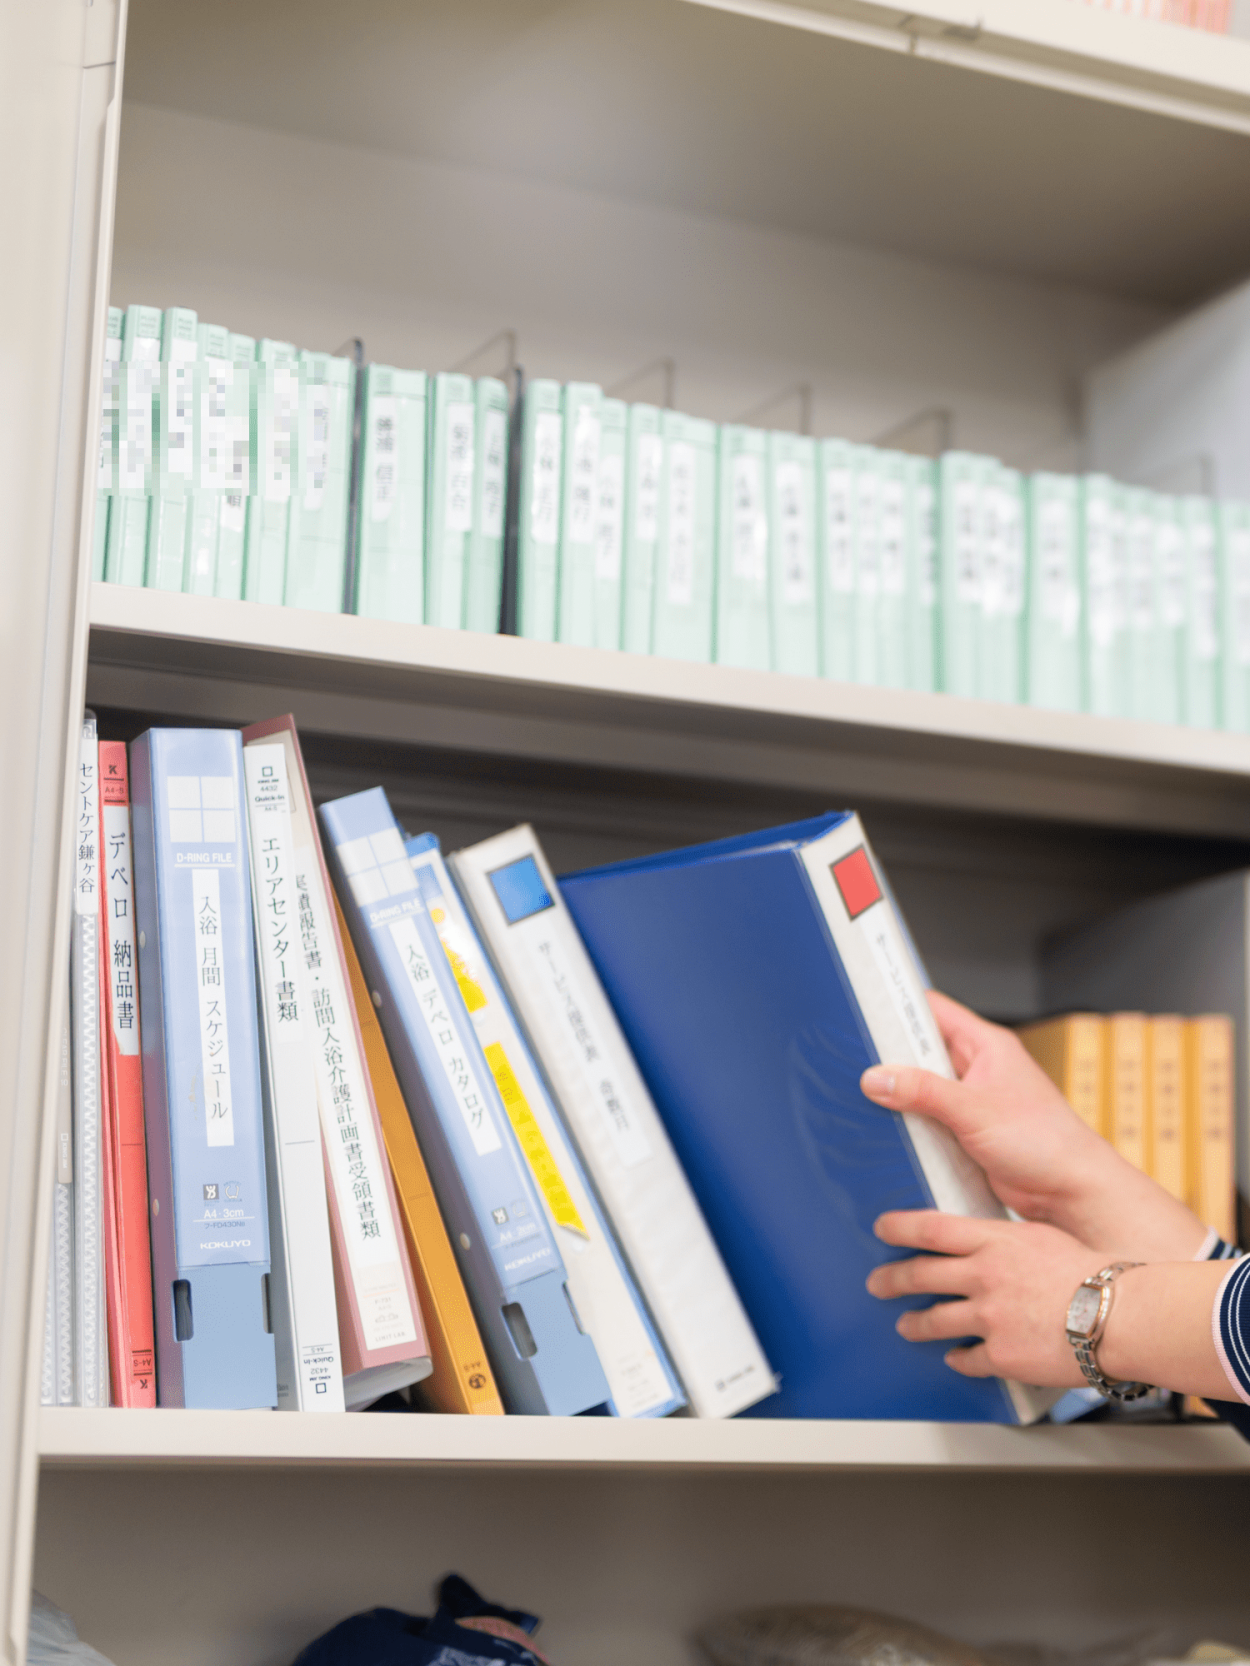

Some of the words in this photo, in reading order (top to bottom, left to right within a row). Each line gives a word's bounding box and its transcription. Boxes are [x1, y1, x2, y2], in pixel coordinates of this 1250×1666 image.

[109, 831, 129, 918] デベロ
[177, 852, 210, 863] D-RING
[211, 852, 233, 863] FILE
[198, 895, 219, 936] 入浴
[261, 837, 300, 1023] エリアセンター書類
[113, 939, 135, 1029] 納品書
[200, 946, 222, 987] 月間
[205, 999, 229, 1119] スケジュール
[407, 944, 430, 983] 入浴
[422, 988, 453, 1046] デベロ
[449, 1056, 485, 1130] カタログ
[199, 1239, 252, 1250] KOKUYO
